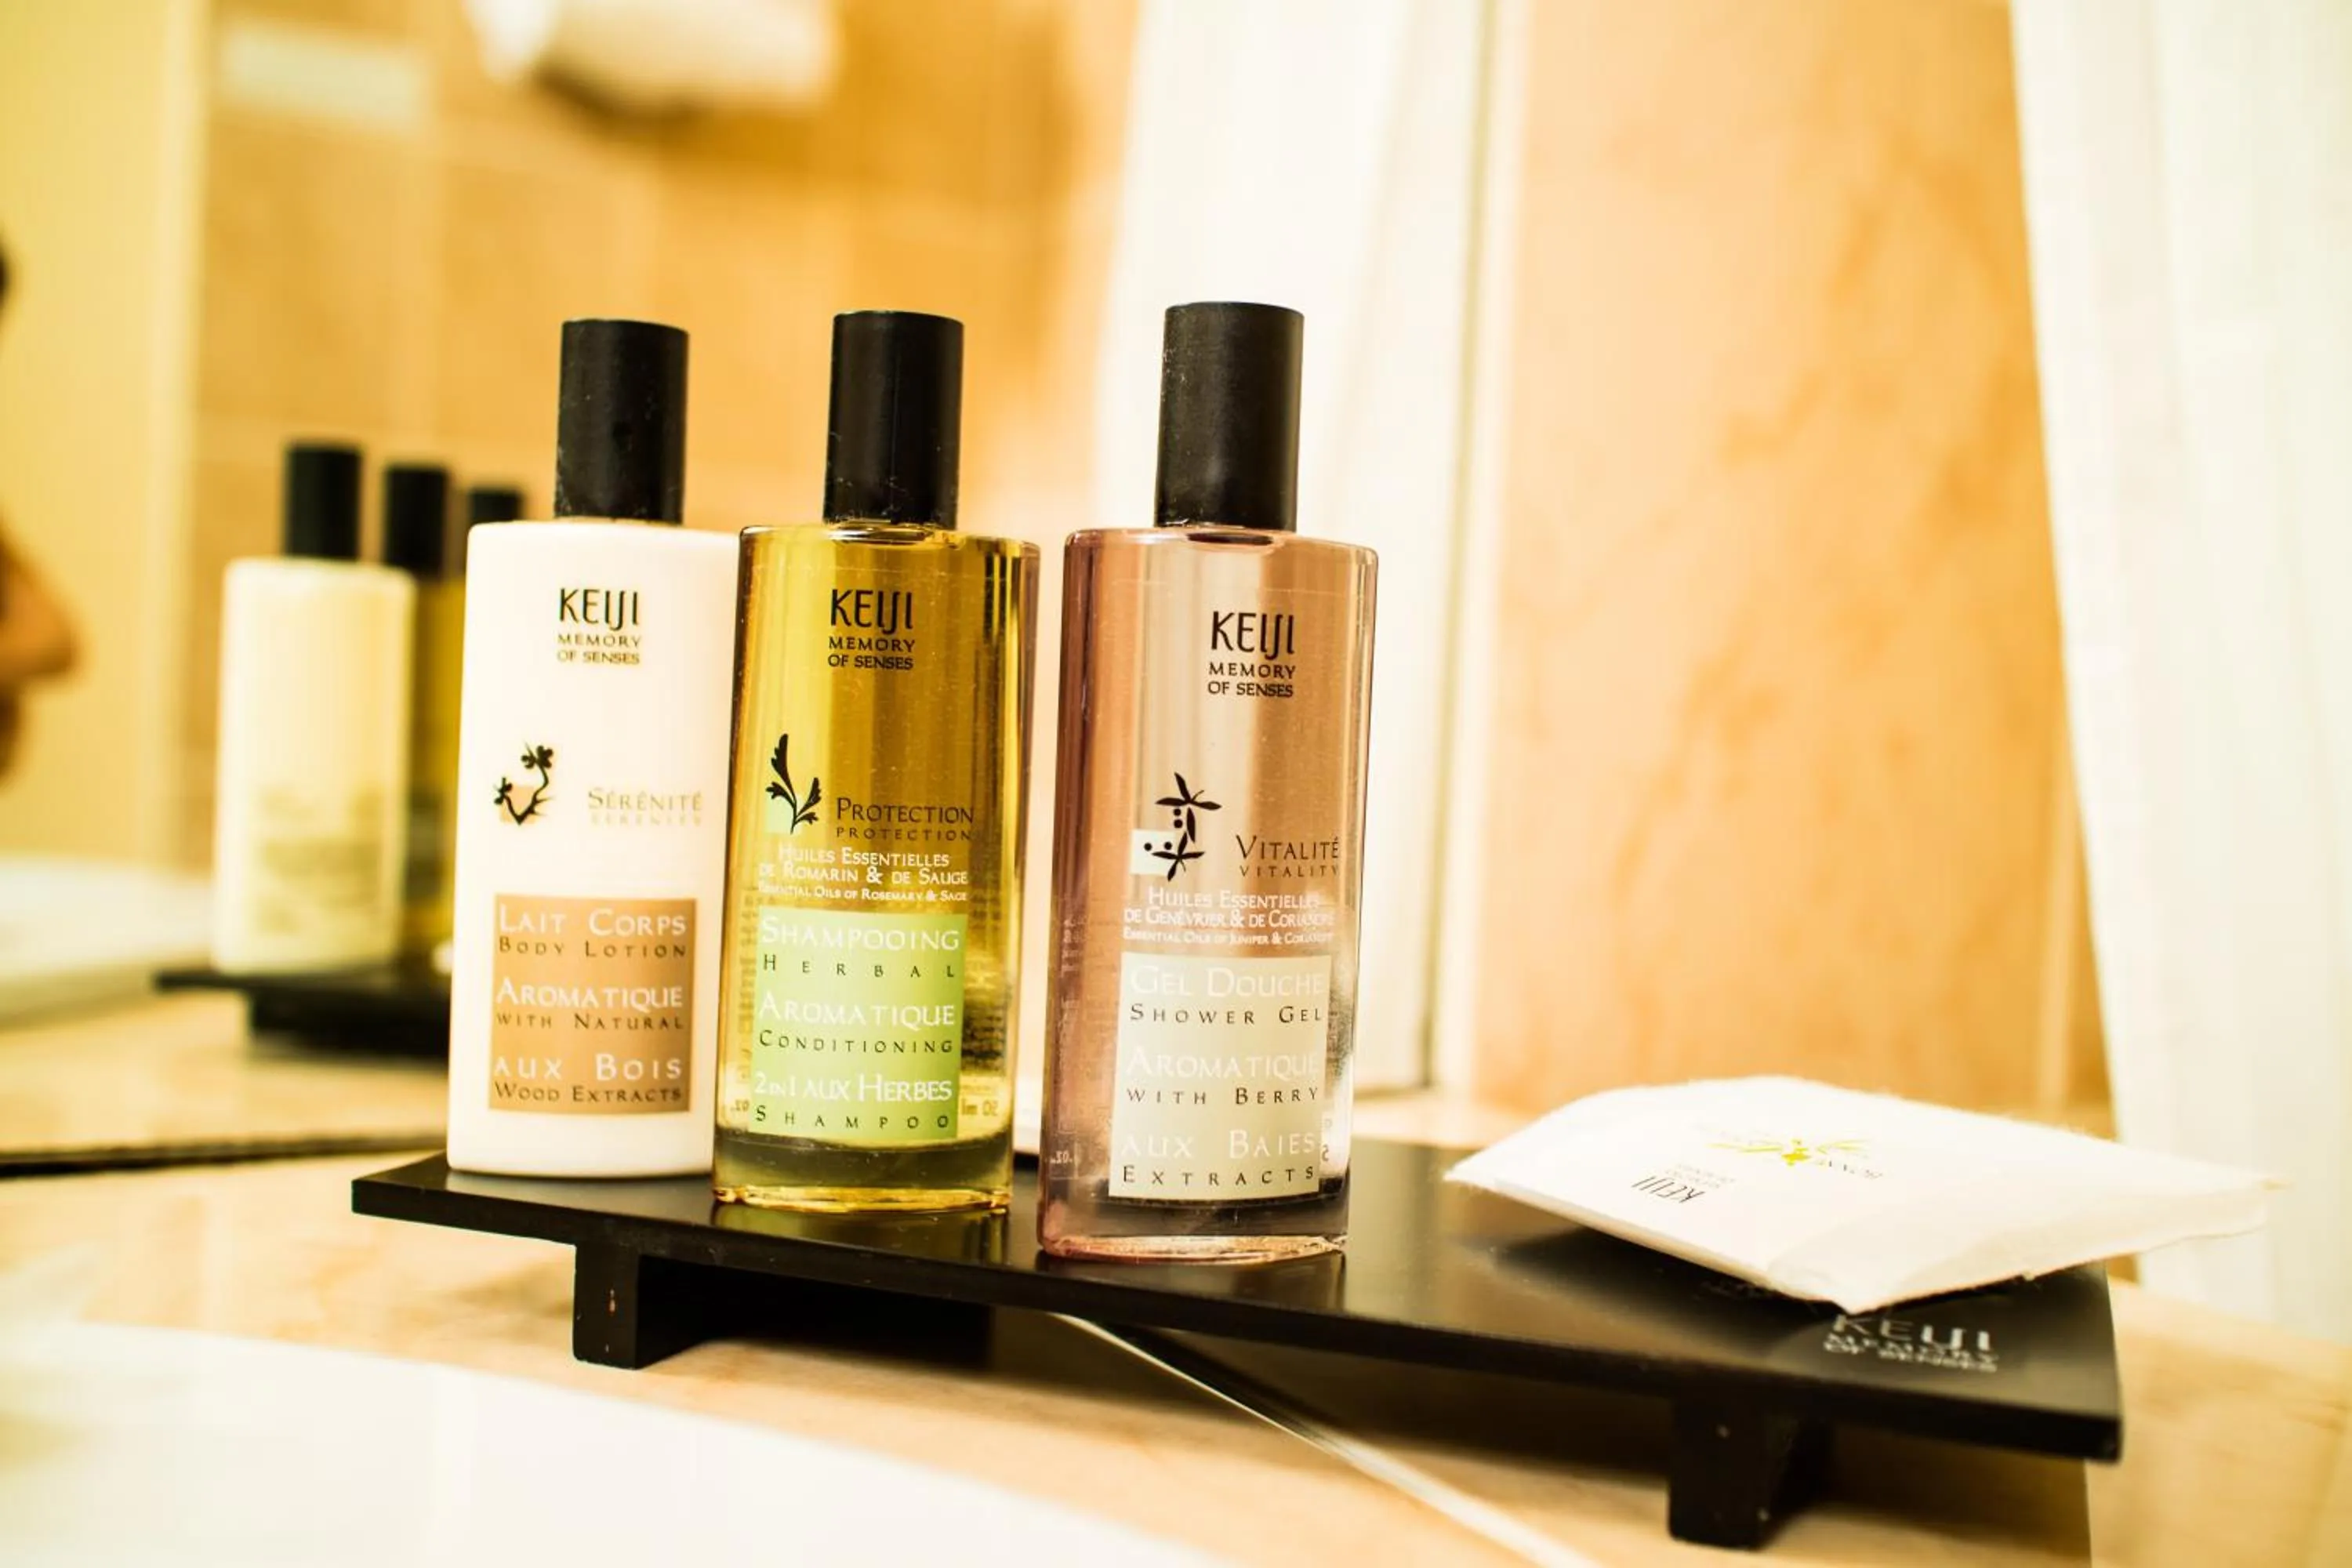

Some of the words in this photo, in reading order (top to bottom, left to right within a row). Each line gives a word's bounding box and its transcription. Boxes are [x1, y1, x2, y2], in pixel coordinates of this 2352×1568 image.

[559, 588, 639, 631] KEIJI
[830, 590, 913, 634] KEIJI
[557, 633, 641, 648] MEMORY
[829, 637, 916, 652] MEMORY
[1211, 612, 1295, 660] KEIJI
[557, 652, 576, 663] OF
[583, 652, 640, 664] SENSES
[828, 654, 848, 668] OF
[855, 655, 913, 670] SENSES
[1208, 662, 1297, 679] MEMORY
[1207, 681, 1230, 695] OF
[1236, 683, 1294, 698] SENSES
[837, 797, 974, 824] PROTECTION
[837, 827, 971, 840] PROTECTION
[779, 842, 836, 863] HUILES
[841, 847, 950, 867] ESSENTIELLES
[1236, 834, 1339, 860] VITALITÉ
[784, 860, 858, 882] ROMARIN
[866, 866, 883, 884] &
[892, 871, 911, 884] DE
[919, 868, 969, 885] SAUGE
[1240, 865, 1339, 877] VITALITY
[815, 885, 841, 899] OILS
[844, 890, 858, 899] OF
[862, 888, 923, 901] ROSEMARY
[940, 891, 967, 902] SAGE
[1149, 886, 1212, 907] HUILES
[499, 904, 566, 933] LAIT
[589, 908, 686, 936] CORPS
[1124, 907, 1142, 923] DE
[1229, 909, 1245, 927] &
[1249, 913, 1266, 927] DE
[761, 916, 960, 951] SHAMPOOING
[499, 936, 564, 955] BODY
[585, 941, 686, 957] LOTION
[763, 954, 954, 978] HERBAL
[1131, 965, 1193, 996] GEL
[1207, 967, 1325, 997] DOUCHE
[496, 978, 683, 1013] AROMATIQUE
[496, 1014, 552, 1029] WITH
[575, 1014, 684, 1029] NATURAL
[759, 991, 955, 1031] AROMATIQUE
[1131, 1004, 1255, 1024] SHOWER
[1279, 1006, 1322, 1023] GEL
[760, 1029, 953, 1054] CONDITIONING
[493, 1056, 563, 1080] AUX
[596, 1053, 682, 1081] BOIS
[1126, 1047, 1320, 1082] AROMATIQUE
[495, 1082, 560, 1101] WOOD
[573, 1086, 681, 1102] EXTRACTS
[802, 1078, 851, 1102] AUX
[859, 1073, 953, 1102] HERBES
[1127, 1087, 1207, 1105] WITH
[1236, 1087, 1319, 1105] BERRY
[756, 1105, 949, 1129] SHAMPOO
[1121, 1134, 1195, 1158] AUX
[1229, 1129, 1317, 1160] BAIES
[1123, 1166, 1314, 1186] EXTRACTS
